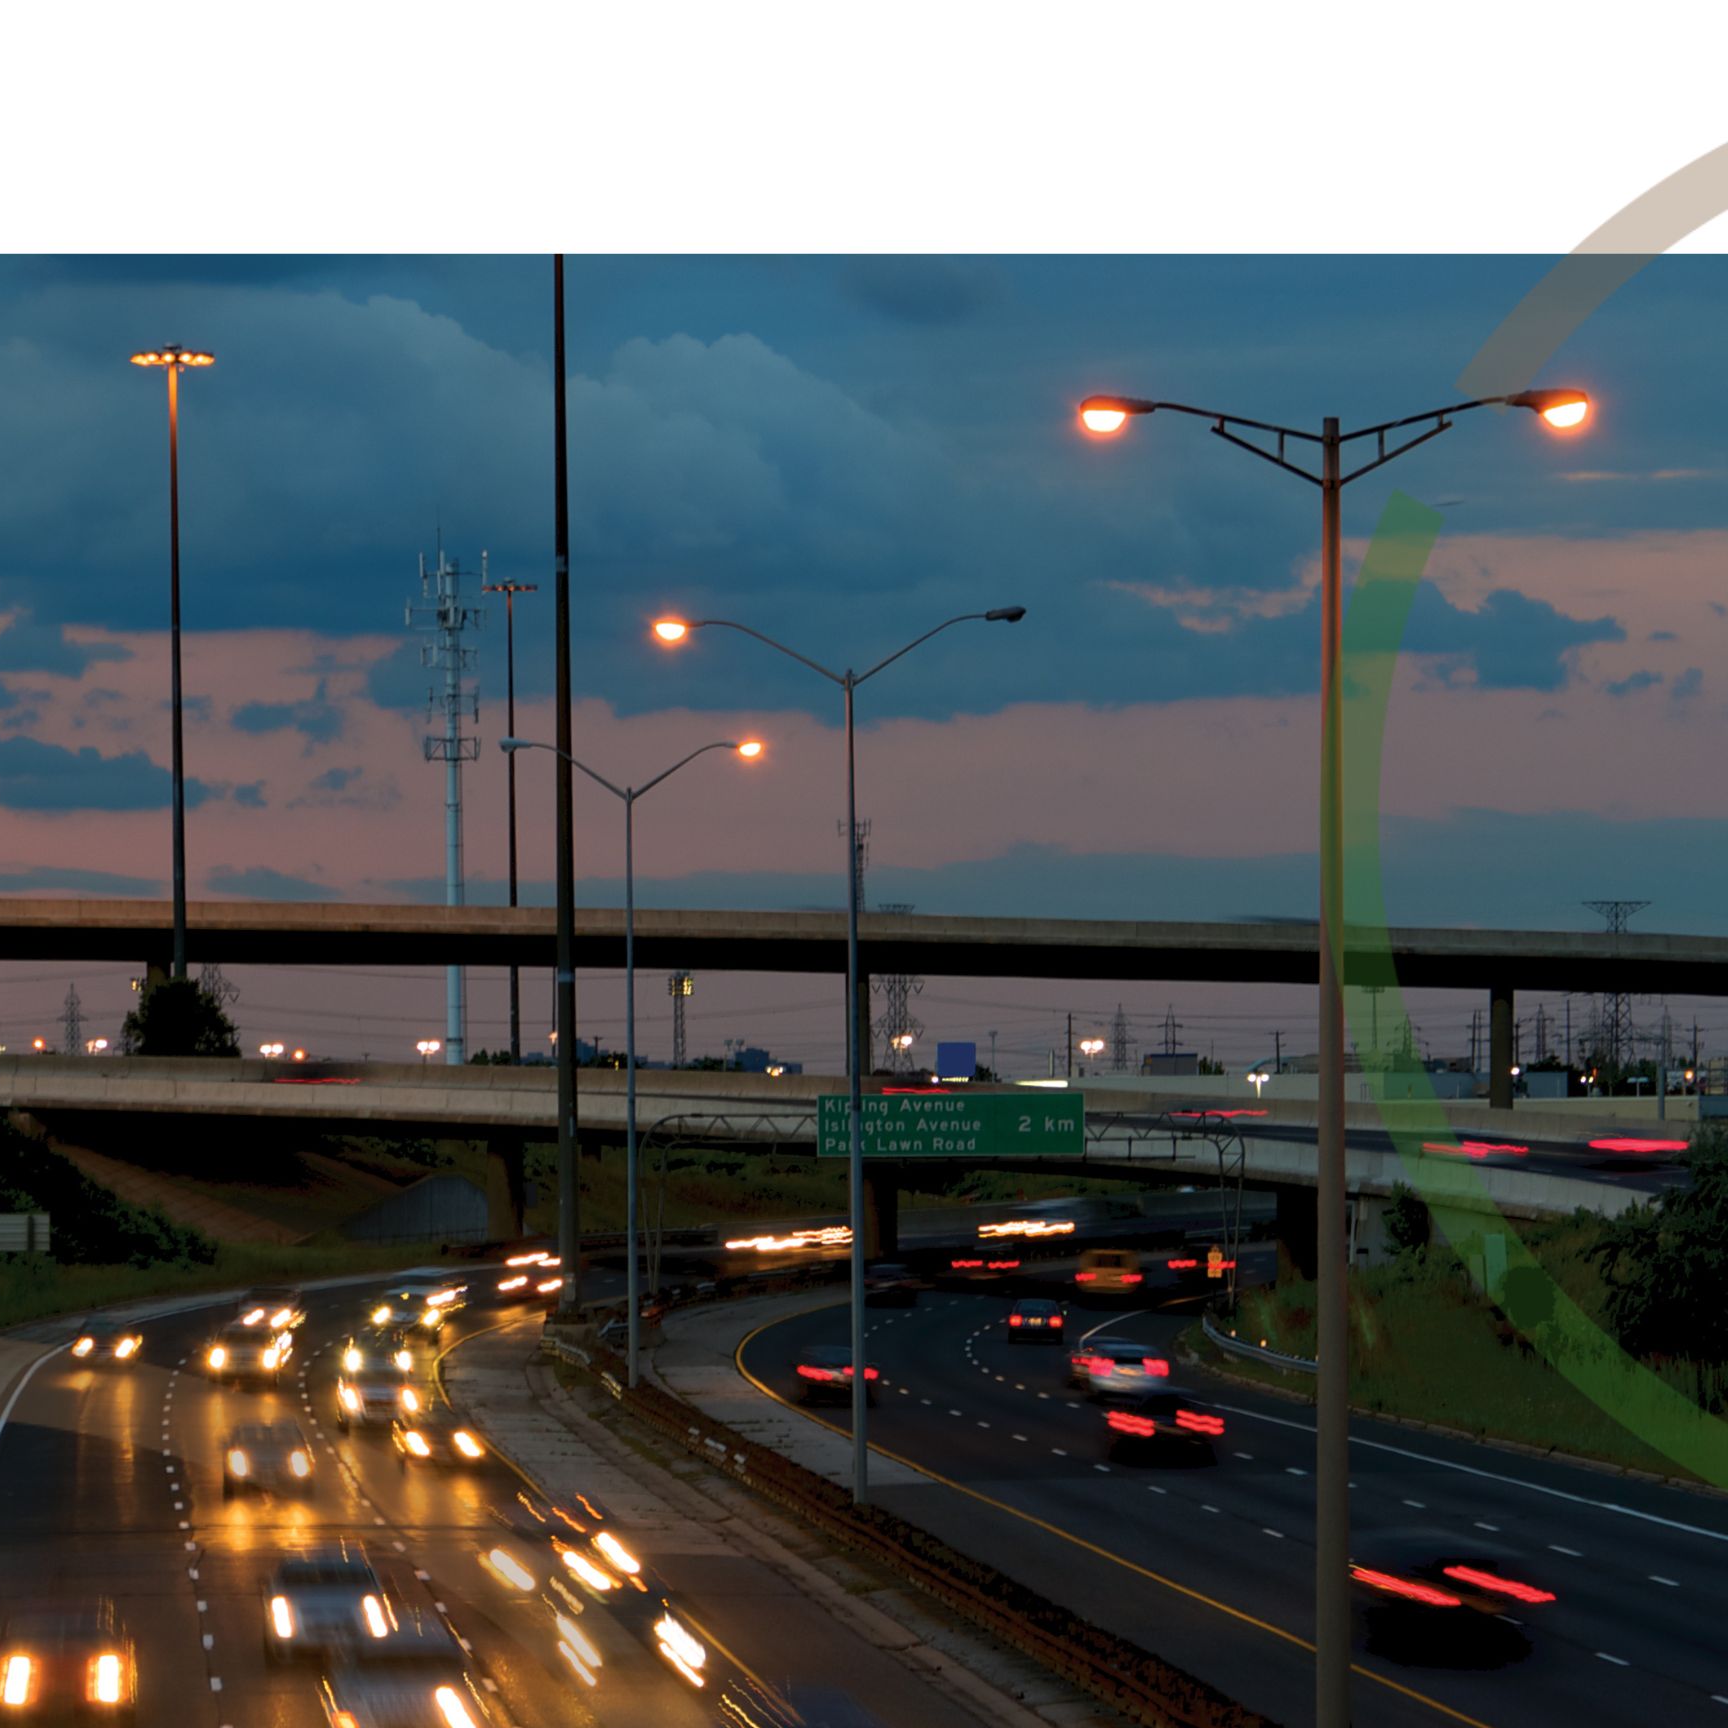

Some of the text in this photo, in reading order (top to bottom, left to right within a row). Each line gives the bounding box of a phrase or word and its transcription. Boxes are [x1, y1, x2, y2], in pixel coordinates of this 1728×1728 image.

[825, 1098, 965, 1117] Kiping Avenue
[916, 1118, 981, 1132] Avenue
[1018, 1115, 1075, 1132] 2 km
[877, 1137, 923, 1152] Lawn
[933, 1137, 976, 1151] Road
